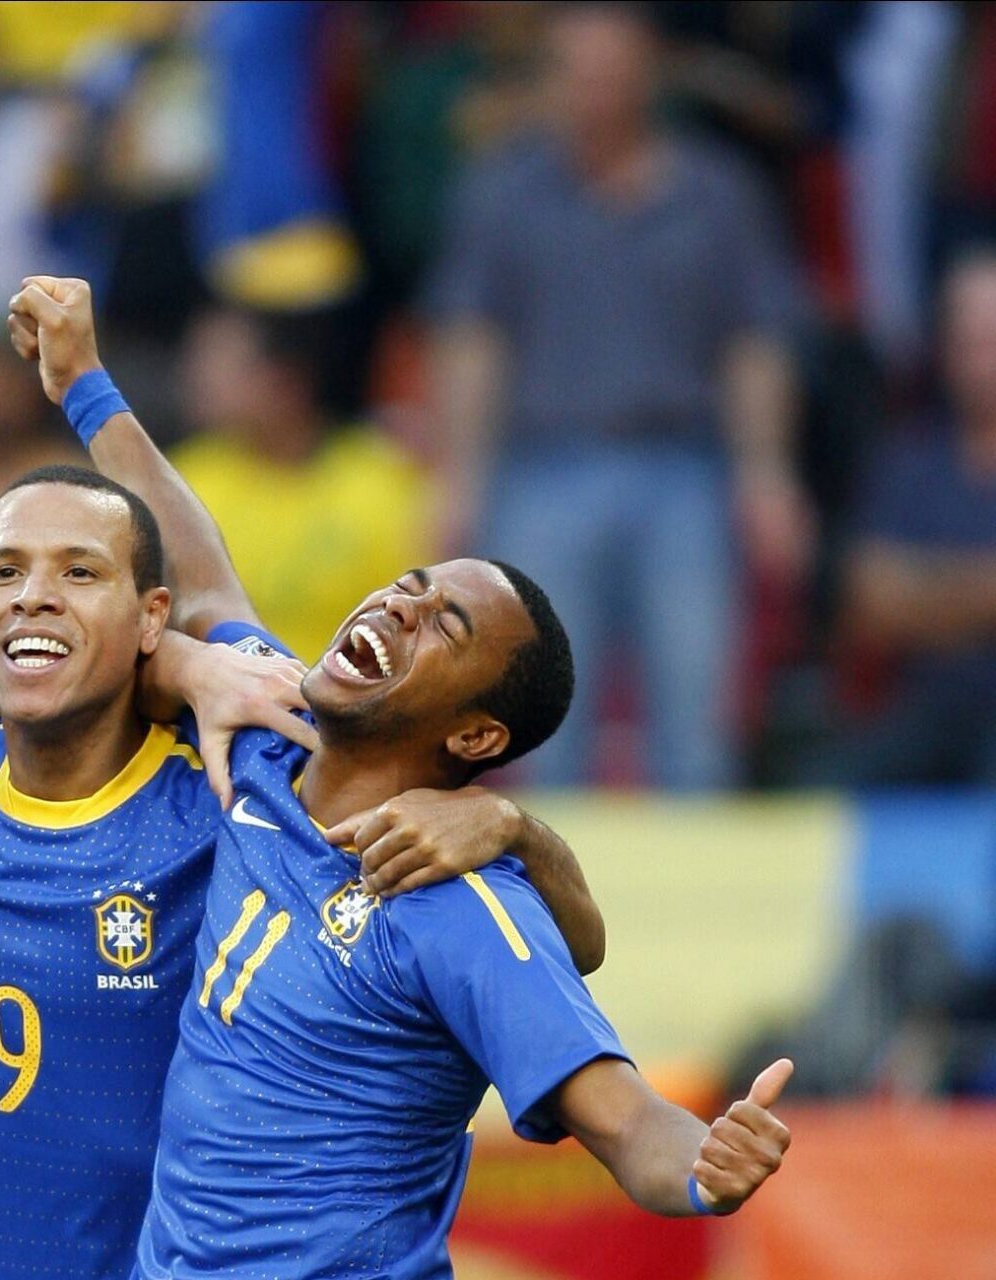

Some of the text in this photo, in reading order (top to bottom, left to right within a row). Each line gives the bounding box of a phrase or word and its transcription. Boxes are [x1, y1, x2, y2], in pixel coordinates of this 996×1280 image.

[114, 924, 135, 934] CBF
[198, 889, 291, 1026] 11
[97, 975, 159, 990] BRASIL
